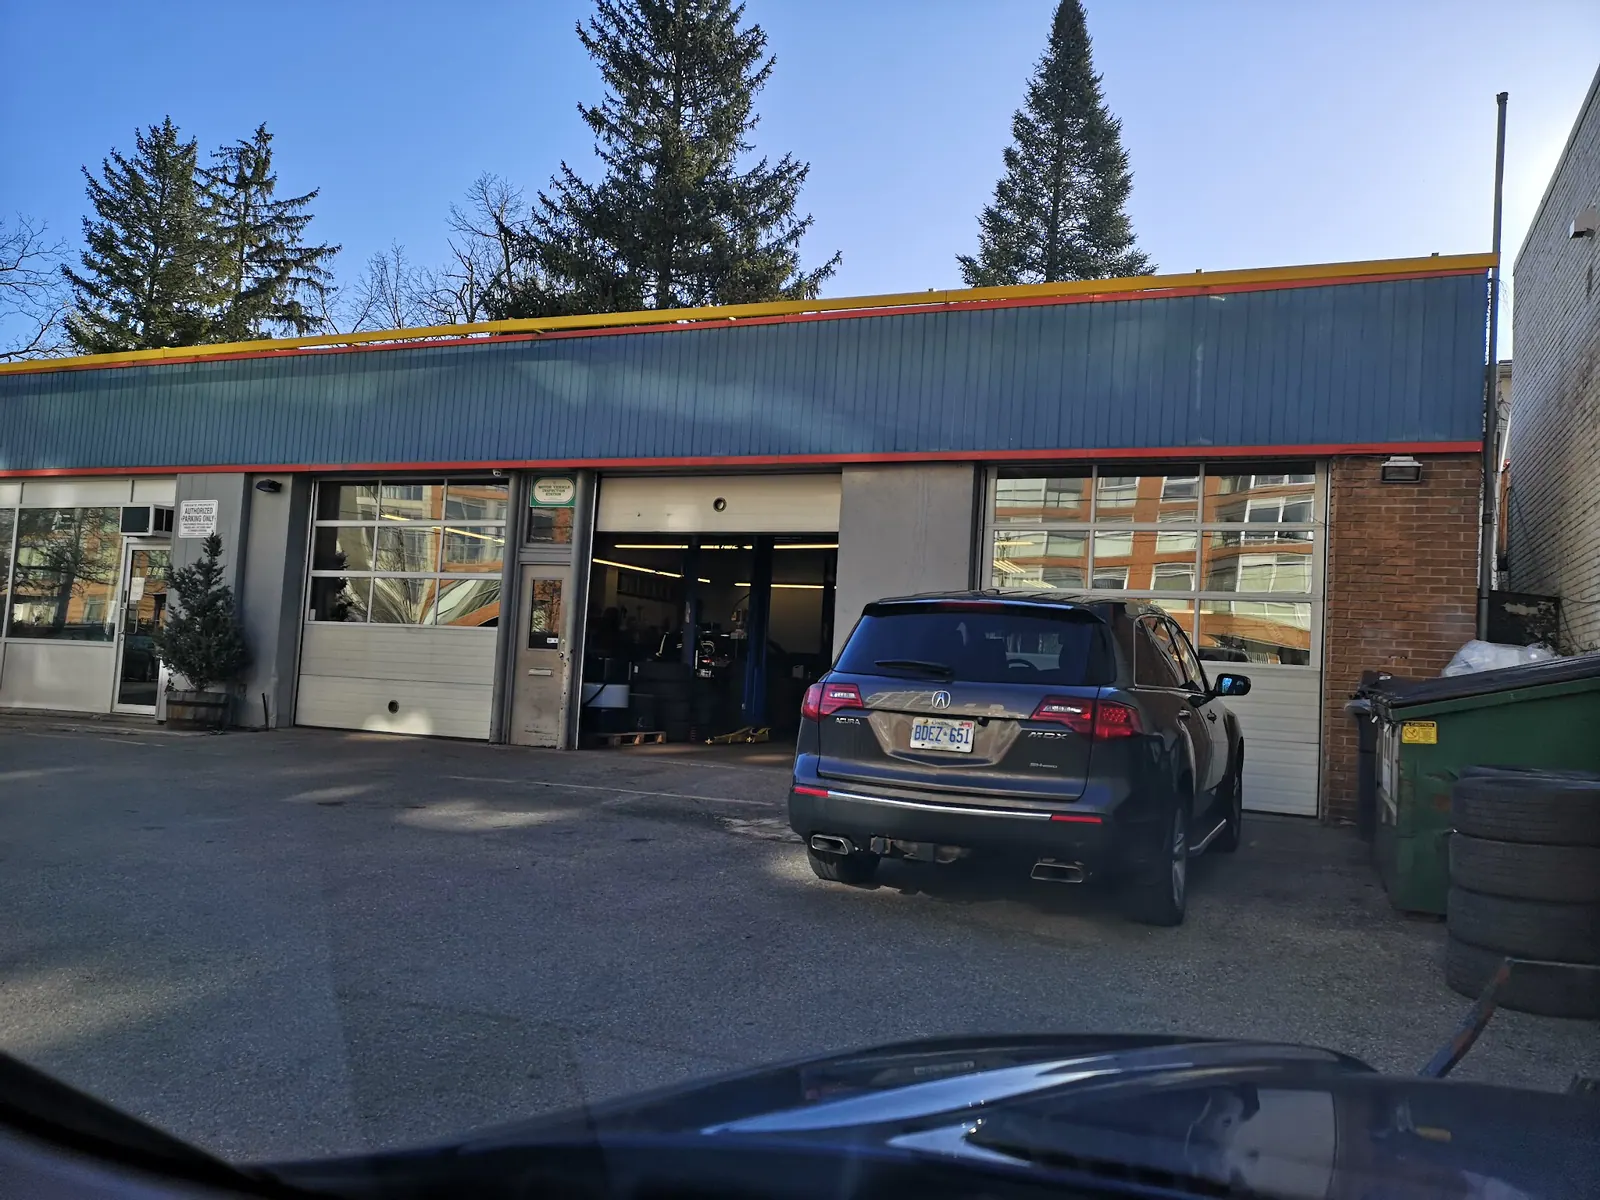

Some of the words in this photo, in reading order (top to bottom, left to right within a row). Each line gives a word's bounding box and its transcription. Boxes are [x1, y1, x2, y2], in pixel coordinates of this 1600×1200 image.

[835, 717, 861, 725] ACURA
[914, 725, 943, 742] BDEZ
[949, 727, 970, 744] 651
[1028, 731, 1067, 740] MDX
